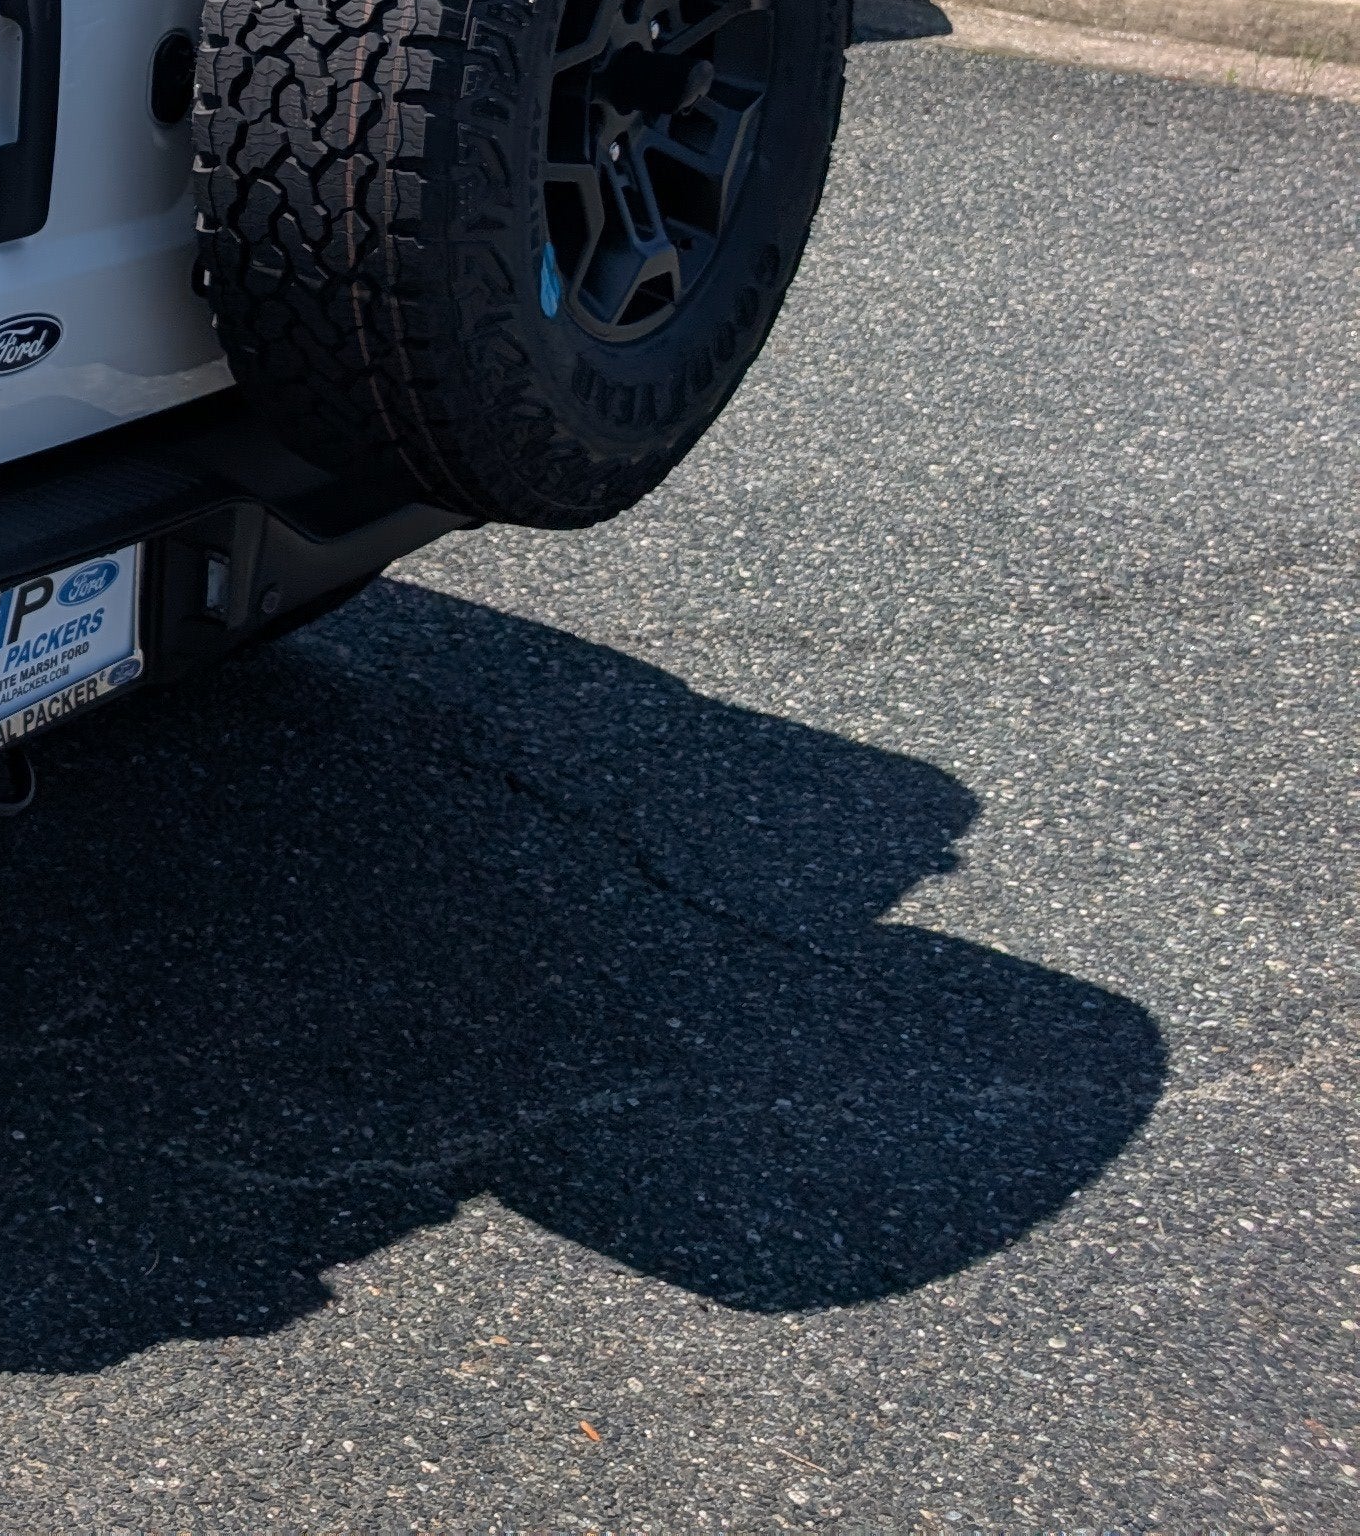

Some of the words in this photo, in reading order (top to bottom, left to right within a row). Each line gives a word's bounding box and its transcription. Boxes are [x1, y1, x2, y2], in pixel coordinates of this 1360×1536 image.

[3, 607, 105, 673] PACKERS
[19, 656, 59, 682] MARSH
[61, 641, 90, 663] FORD
[0, 664, 70, 704] ALPACKER.COM
